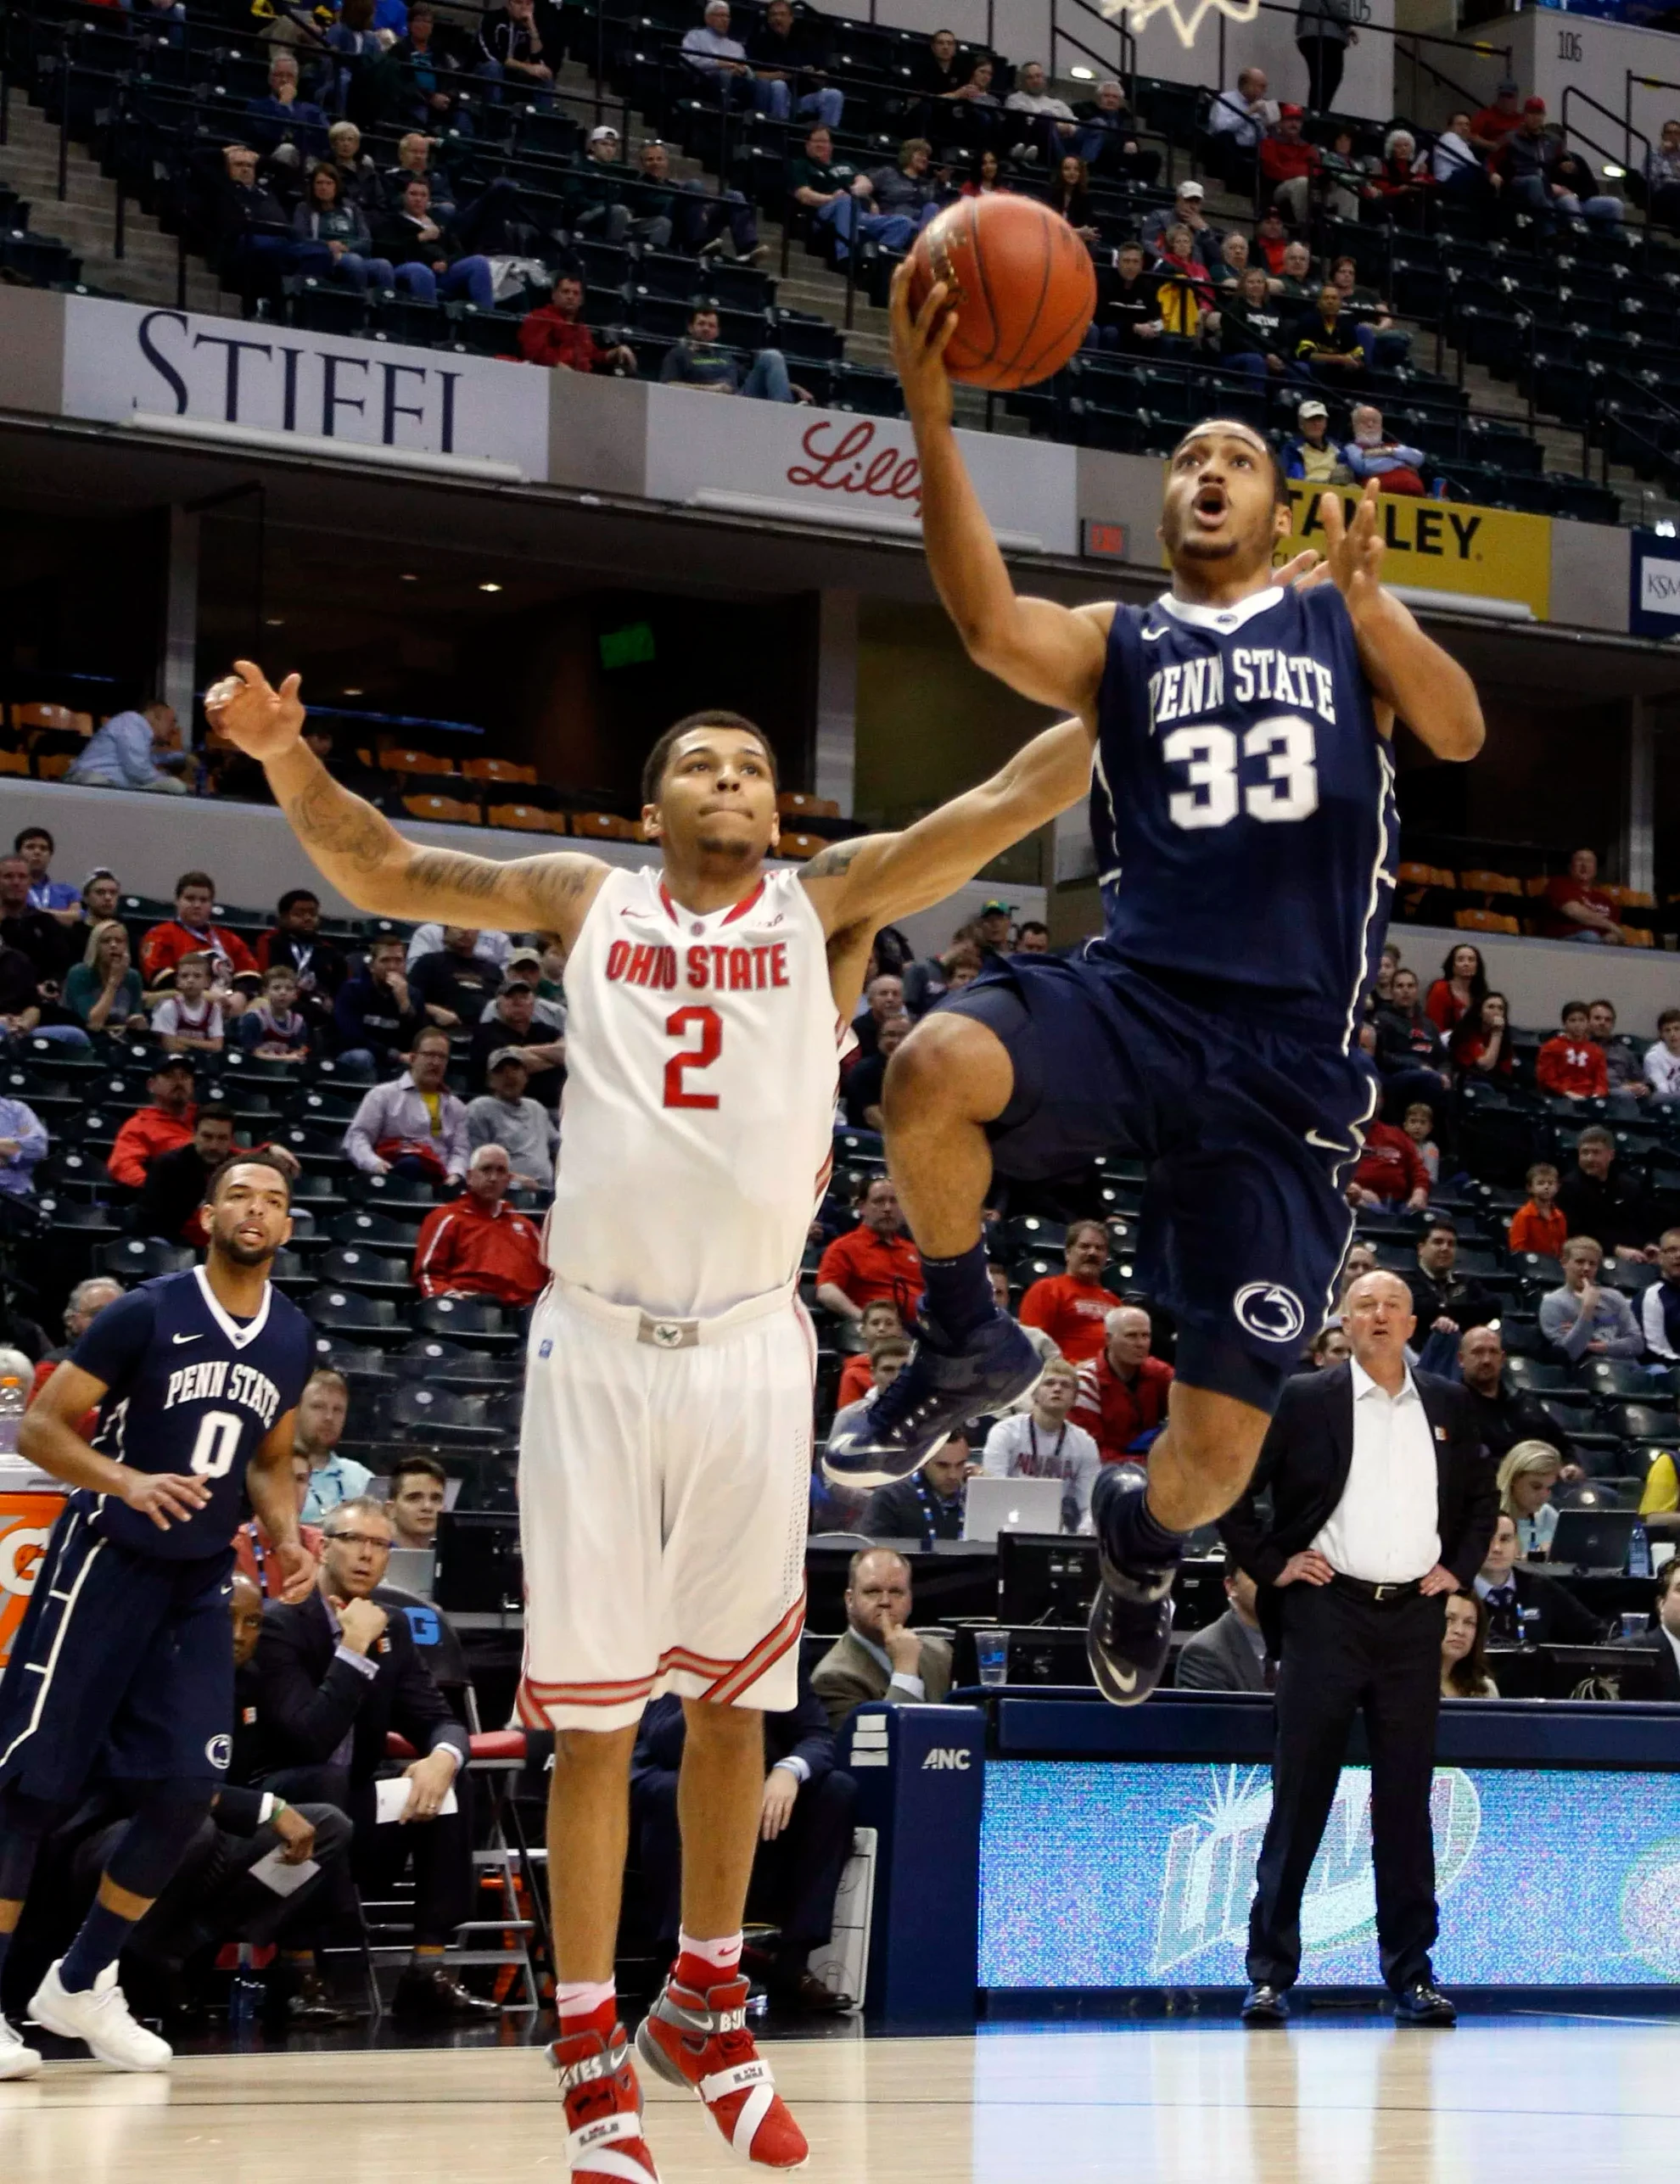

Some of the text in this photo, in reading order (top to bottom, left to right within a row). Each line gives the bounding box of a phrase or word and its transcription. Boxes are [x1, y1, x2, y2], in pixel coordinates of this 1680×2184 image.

[1558, 30, 1582, 62] 106
[1147, 647, 1336, 736] PENN STATE
[1162, 714, 1319, 831] 33
[605, 939, 791, 990] OHIO STATE
[663, 1005, 723, 1110] 2
[163, 1361, 281, 1430] PENN STATE
[189, 1409, 244, 1479] 0
[0, 1526, 50, 1596] G
[921, 1749, 972, 1770] ANC
